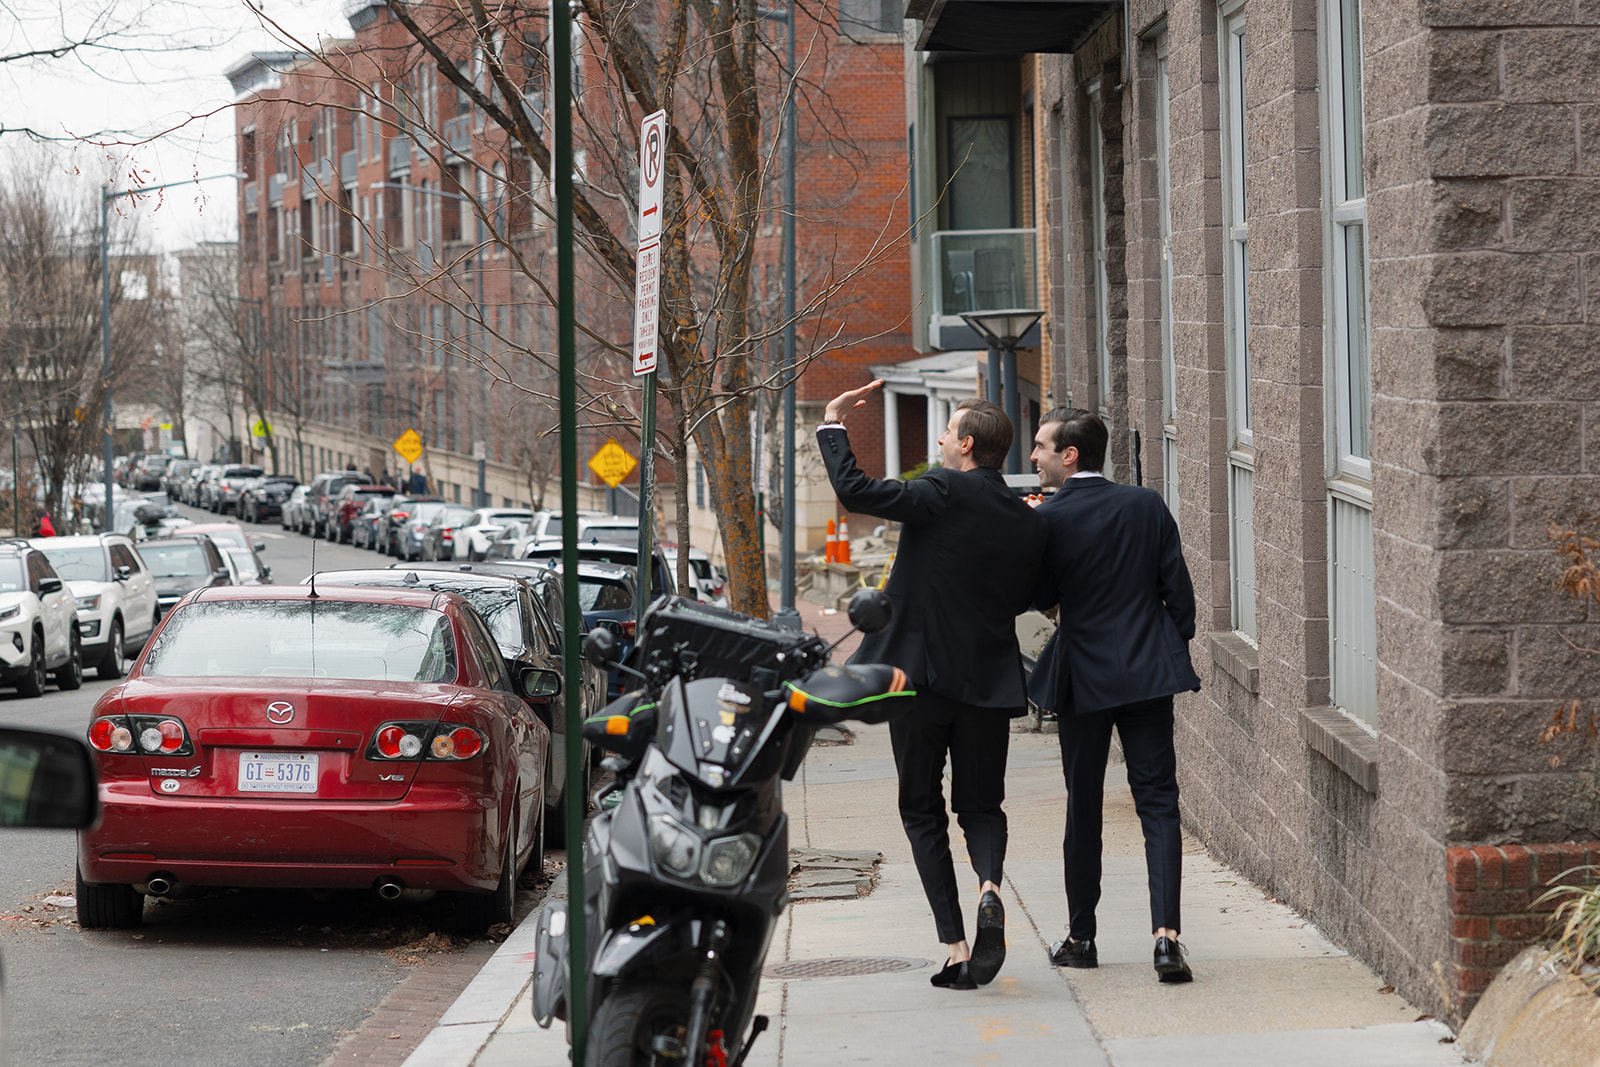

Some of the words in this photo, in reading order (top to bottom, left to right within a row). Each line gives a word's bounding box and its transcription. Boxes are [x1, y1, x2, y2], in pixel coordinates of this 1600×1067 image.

[640, 266, 657, 283] RESIDENT
[641, 281, 655, 297] PERMIT
[639, 294, 656, 310] PARKING
[642, 310, 653, 324] ONLY
[246, 763, 263, 780] GI
[277, 763, 310, 781] 5376
